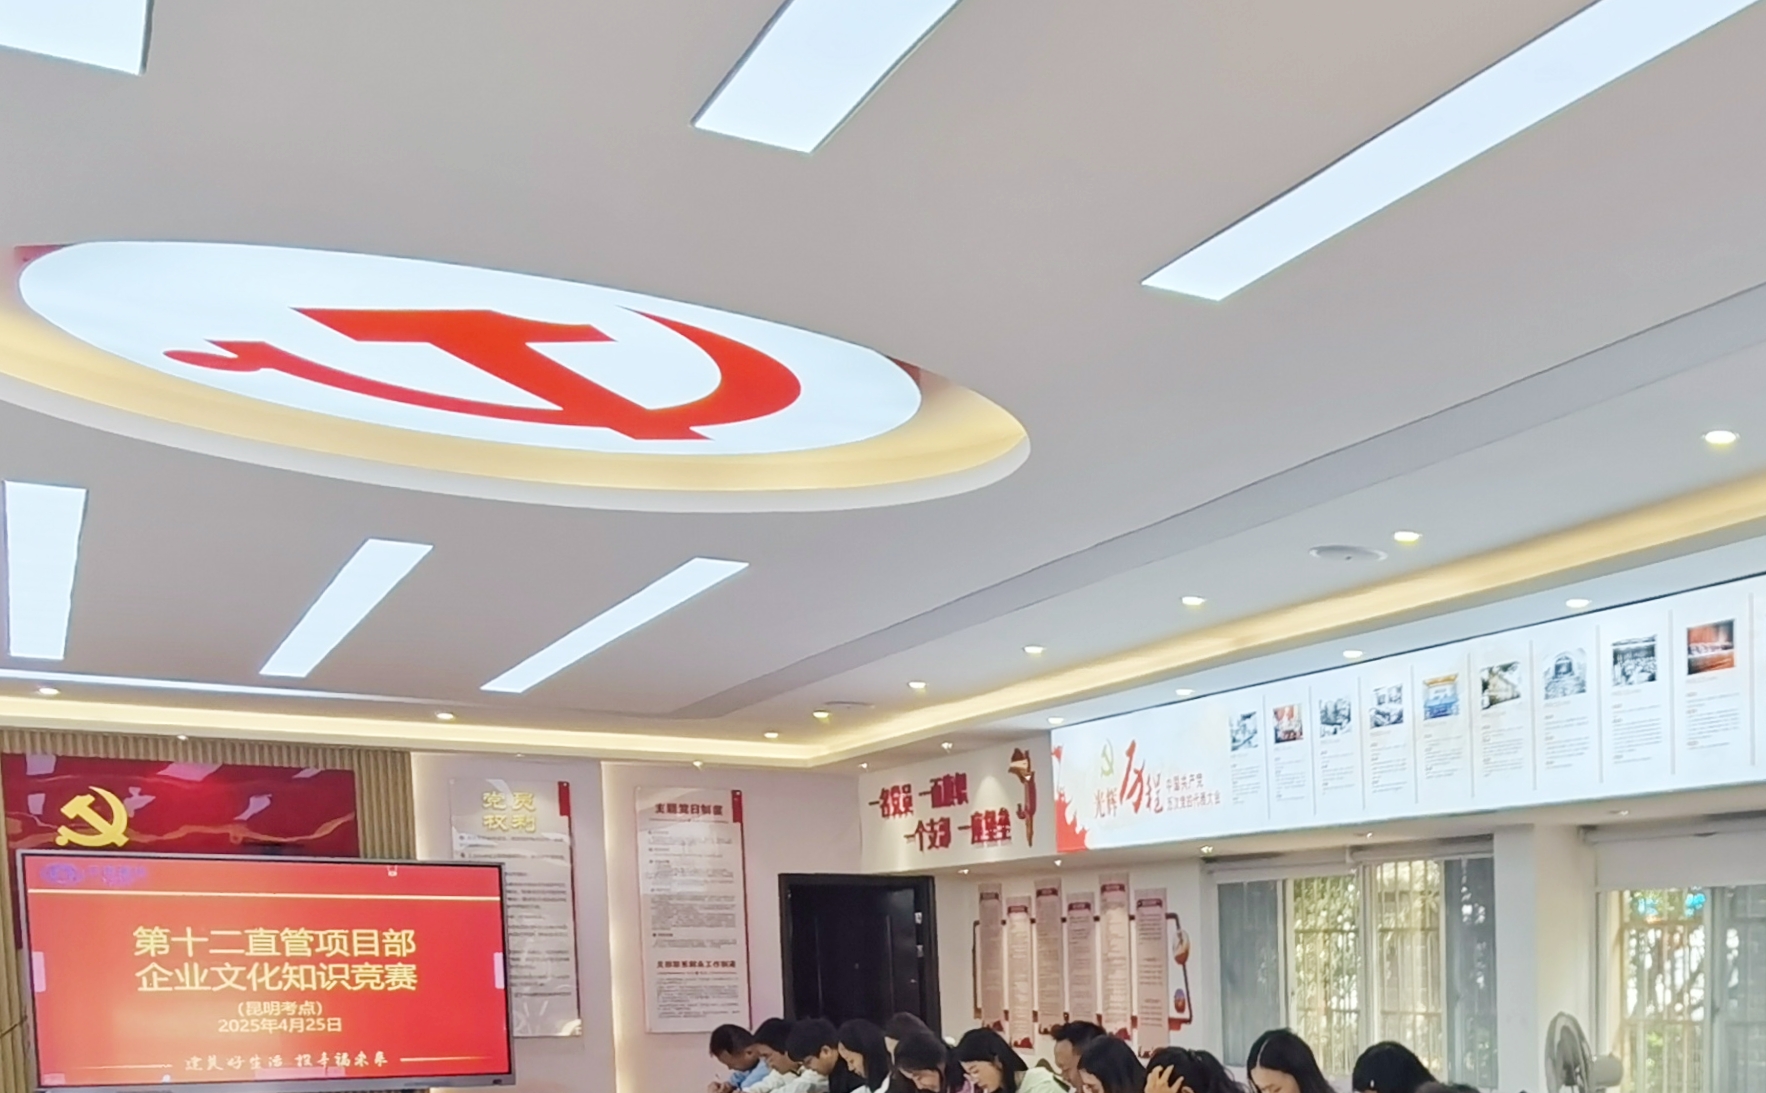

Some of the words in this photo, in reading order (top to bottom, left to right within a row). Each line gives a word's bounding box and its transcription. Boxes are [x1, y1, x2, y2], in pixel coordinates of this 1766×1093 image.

[482, 791, 536, 812] 党员
[868, 783, 914, 818] 一名党员
[482, 814, 536, 834] 权利
[903, 817, 952, 852] 一个支部
[133, 925, 418, 958] 第十二直管项目部
[134, 961, 419, 993] 企业文化知识竞赛
[236, 1000, 324, 1017] （昆明考点）
[217, 1016, 343, 1034] 2025年4月25日
